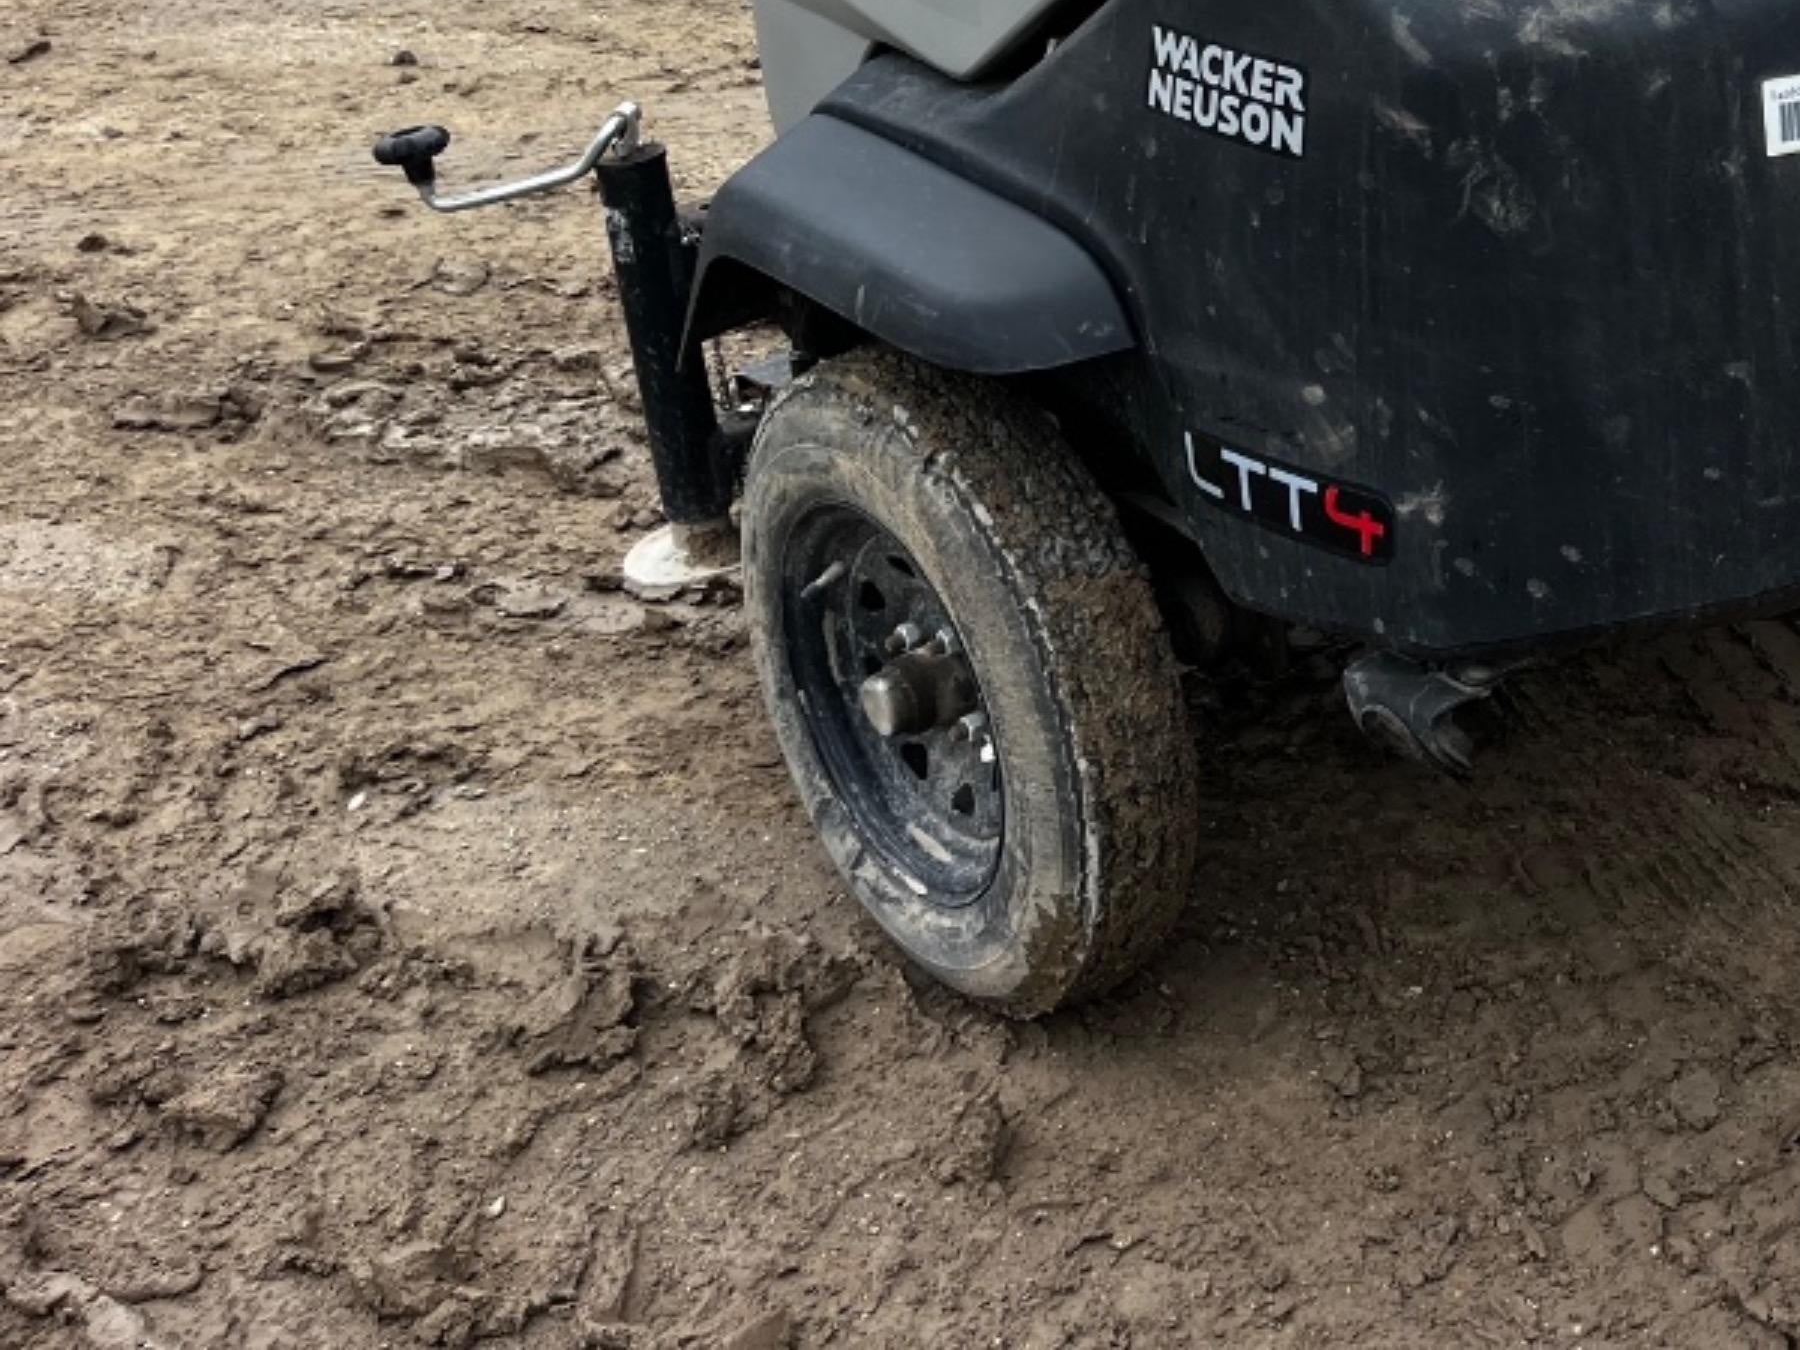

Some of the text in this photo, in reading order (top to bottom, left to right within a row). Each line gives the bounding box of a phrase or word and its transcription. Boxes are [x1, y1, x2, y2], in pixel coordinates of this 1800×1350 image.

[1148, 68, 1304, 157] NEUSON
[1152, 25, 1305, 112] WACKER
[1184, 431, 1384, 556] LTT4
